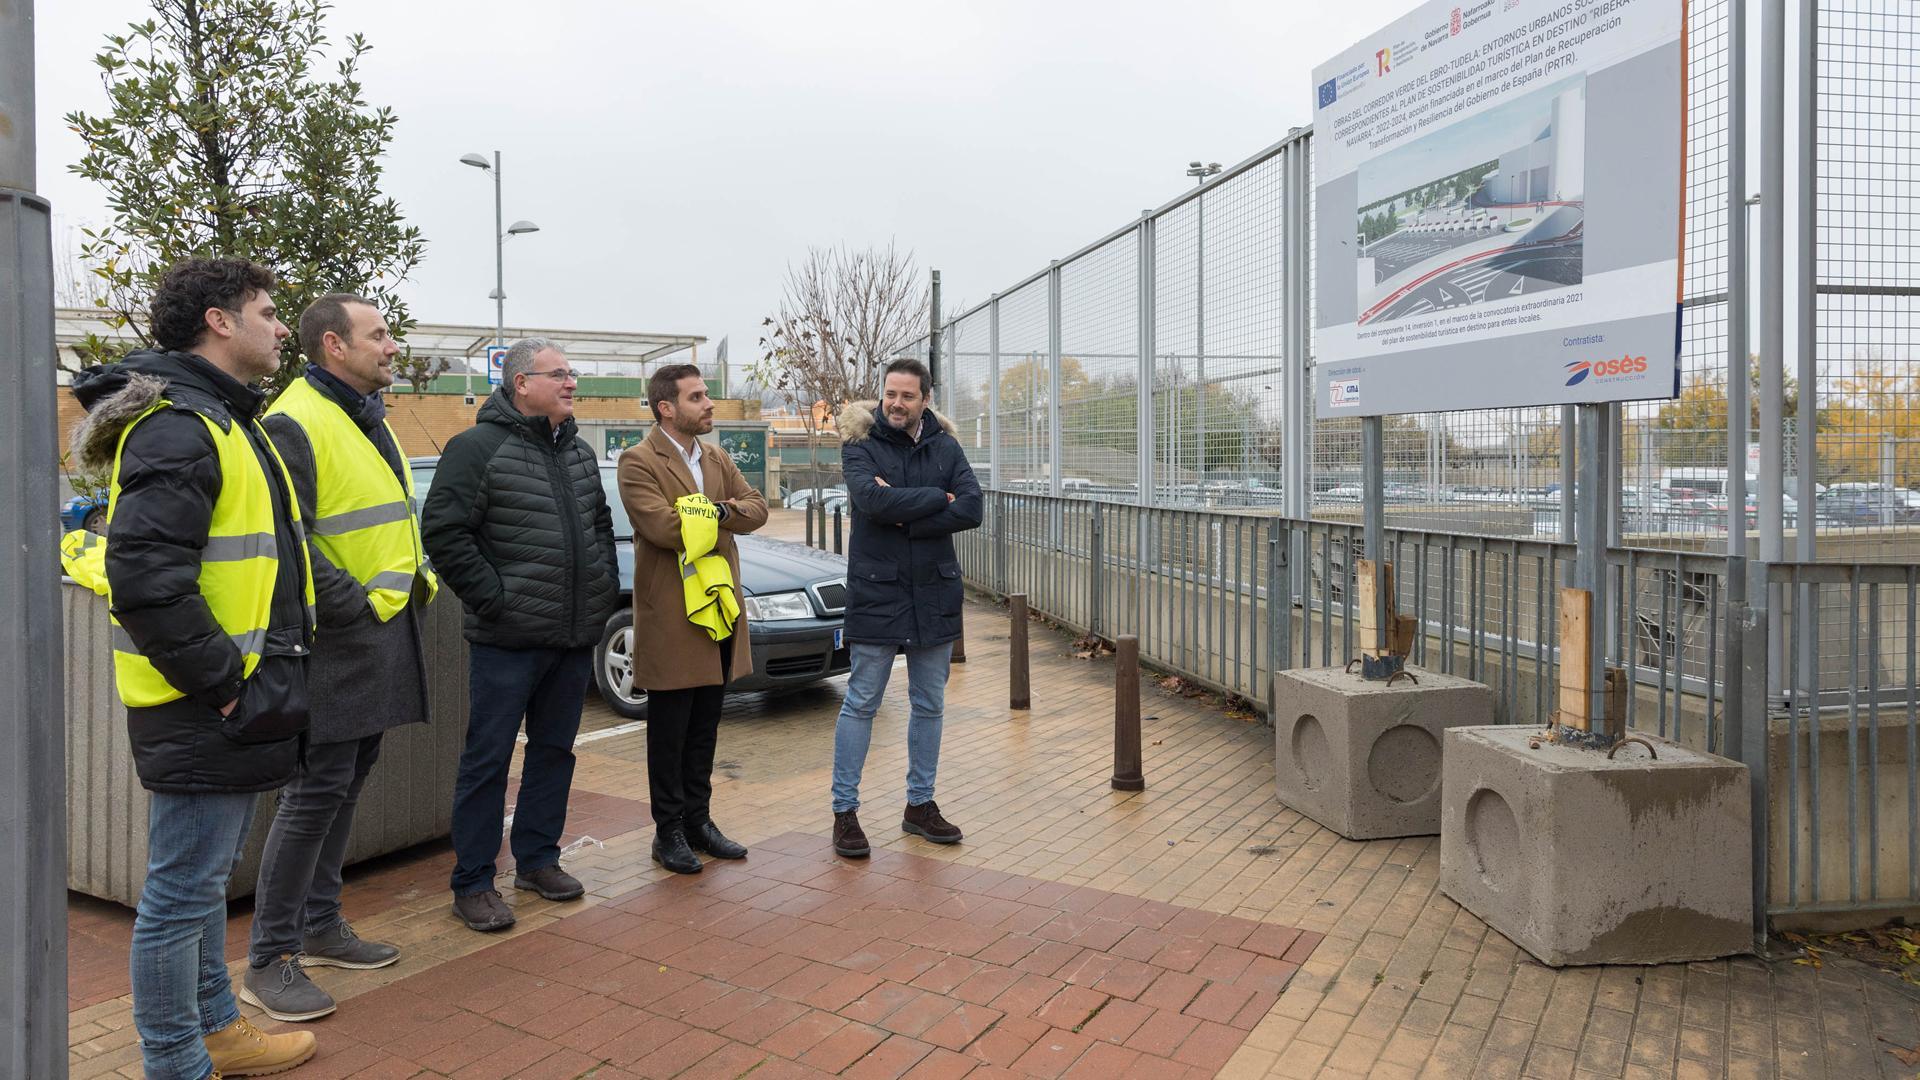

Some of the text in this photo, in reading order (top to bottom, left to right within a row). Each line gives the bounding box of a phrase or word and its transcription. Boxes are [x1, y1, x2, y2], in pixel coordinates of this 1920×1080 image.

[1425, 23, 1448, 40] Gobierno
[1463, 10, 1491, 29] Gobernua
[1420, 44, 1428, 52] de
[1428, 34, 1448, 48] Navarra
[1334, 114, 1352, 128] OBRAS
[1352, 108, 1362, 119] DEL
[1364, 92, 1394, 114] CORREDOR
[1394, 83, 1414, 98] VERDE
[1416, 74, 1428, 87] DEL
[1430, 49, 1480, 80] EBRO-TUDELA:
[1482, 26, 1527, 55] ENTORNOS
[1529, 4, 1572, 33] URBANOS
[1334, 107, 1390, 140] CORRESPONDIENTES
[1390, 103, 1398, 113] AL
[1400, 94, 1416, 110] PLAN
[1418, 89, 1426, 100] DE
[1428, 60, 1486, 96] SOSTENIBILIDAD
[1488, 40, 1530, 68] TURÍSTICA
[1532, 33, 1545, 47] EN
[1546, 14, 1587, 40] DESTINO
[1408, 103, 1428, 118] acción
[1430, 86, 1464, 109] financiada
[1466, 82, 1474, 92] en
[1476, 78, 1483, 88] el
[1484, 68, 1508, 84] marco
[1510, 58, 1522, 72] del
[1524, 52, 1543, 66] Plan
[1546, 45, 1556, 57] de
[1558, 16, 1621, 52] Recuperación
[1369, 124, 1412, 150] Transformación
[1418, 106, 1452, 128] Resiliencia
[1454, 100, 1464, 112] del
[1466, 86, 1499, 108] Gobierno
[1501, 80, 1510, 92] de
[1513, 68, 1542, 88] España
[1544, 51, 1578, 76] (PRTR).
[1378, 326, 1404, 337] componente
[1440, 318, 1446, 326] en
[1447, 316, 1452, 324] el
[1452, 314, 1468, 324] marco
[1470, 312, 1476, 320] de
[1484, 304, 1520, 318] convocatoria
[1521, 297, 1564, 311] extraordinaria
[1566, 292, 1583, 304] 2021
[1389, 336, 1398, 345] plan
[1399, 335, 1405, 343] de
[1406, 329, 1438, 342] sostenibilidad
[1466, 321, 1486, 332] destino
[1488, 320, 1500, 330] para
[1501, 318, 1517, 326] entes
[1519, 313, 1542, 323] locales.
[1562, 334, 1606, 347] Contratista:
